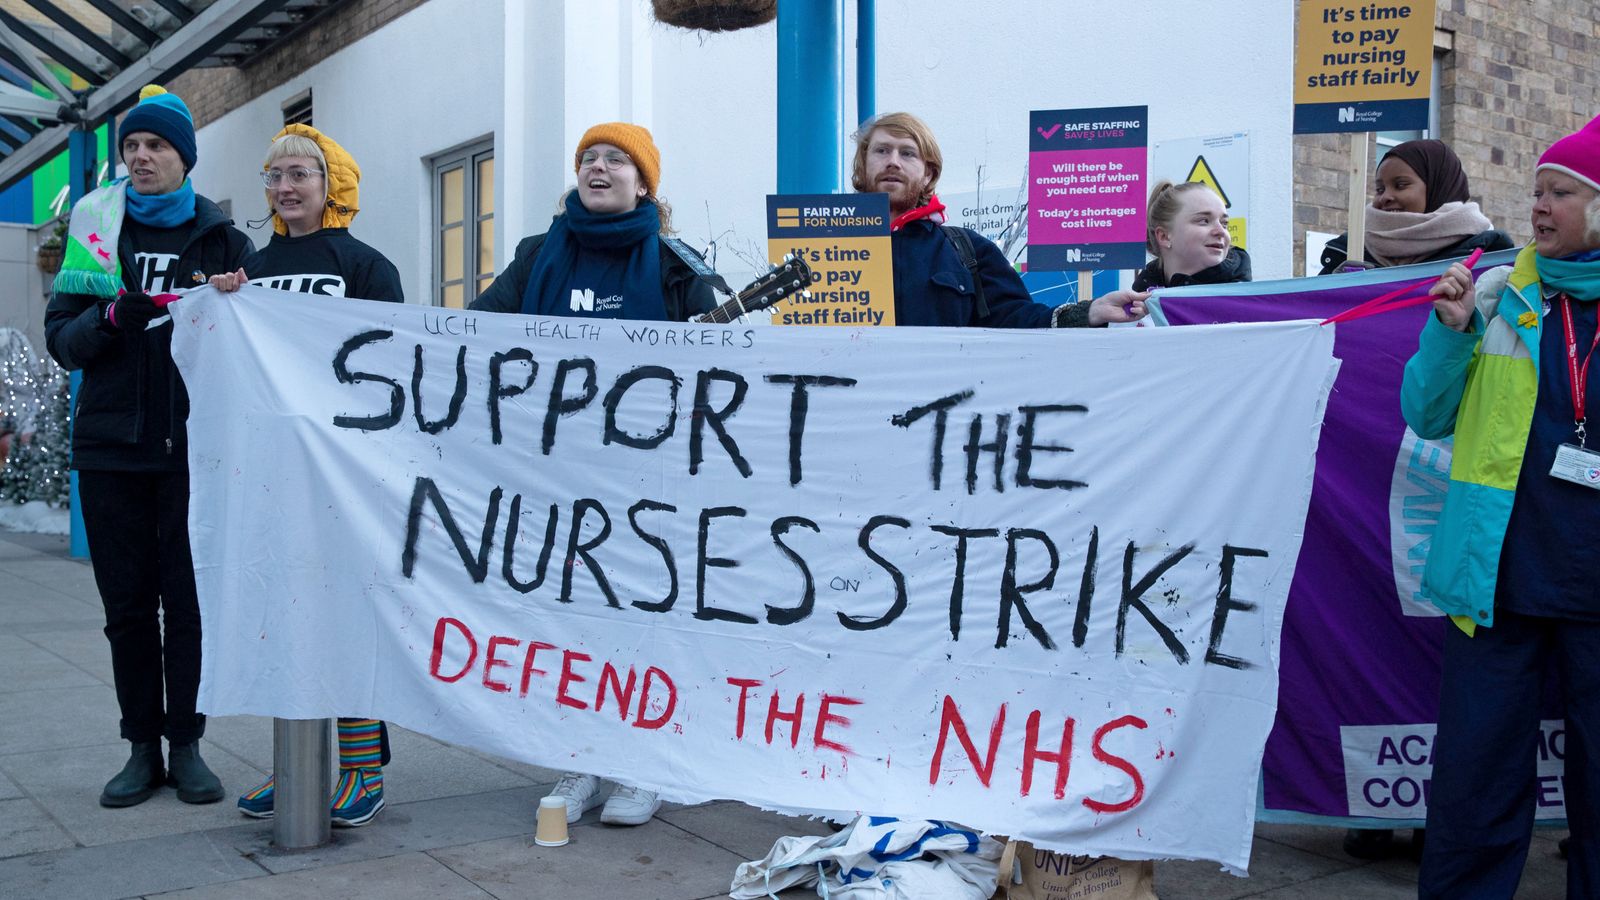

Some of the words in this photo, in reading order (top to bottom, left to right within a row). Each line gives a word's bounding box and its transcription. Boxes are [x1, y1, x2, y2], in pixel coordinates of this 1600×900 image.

[1323, 7, 1355, 23] It’s
[1360, 4, 1411, 20] time
[1332, 30, 1354, 44] to
[1359, 28, 1399, 46] pay
[1323, 46, 1405, 66] nursing
[1307, 70, 1358, 87] staff
[1362, 67, 1420, 87] fairly
[1064, 123, 1091, 132] SAFE
[1092, 120, 1140, 131] STAFFING
[1064, 130, 1095, 139] SAVES
[1097, 129, 1124, 138] LIVES
[1052, 163, 1075, 173] Will
[1077, 162, 1107, 172] there
[1109, 161, 1123, 171] be
[1036, 175, 1078, 185] enough
[1080, 173, 1107, 183] staff
[1107, 172, 1139, 182] when
[1047, 187, 1067, 197] you
[1069, 185, 1096, 195] need
[1098, 184, 1128, 194] care?
[803, 207, 831, 217] FAIR
[833, 206, 856, 216] PAY
[962, 206, 989, 217] Great
[1038, 208, 1079, 219] Today’s
[1081, 207, 1136, 218] shortages
[804, 217, 828, 227] FOR
[830, 216, 883, 227] NURSING
[963, 218, 1003, 231] Hopital
[1061, 220, 1085, 228] cost
[1086, 218, 1112, 228] lives
[824, 246, 870, 261] time
[811, 271, 822, 282] o
[827, 270, 862, 286] pay
[596, 295, 612, 304] Royal
[795, 286, 870, 306] nursing
[596, 304, 602, 312] of
[783, 309, 829, 325] staff
[833, 307, 885, 326] fairly
[424, 313, 477, 336] UCH
[525, 320, 600, 342] HEALTH
[621, 324, 755, 348] WORKERS
[333, 329, 857, 488] SUPPORT
[891, 388, 1089, 495] THE
[402, 476, 820, 626] NURSES
[830, 576, 860, 592] ON
[836, 514, 1269, 671] STRIKE
[429, 616, 678, 730] DEFEND
[726, 677, 865, 757] THE
[929, 694, 1148, 814] NHS
[1085, 865, 1119, 881] College
[1083, 875, 1122, 896] Hospital
